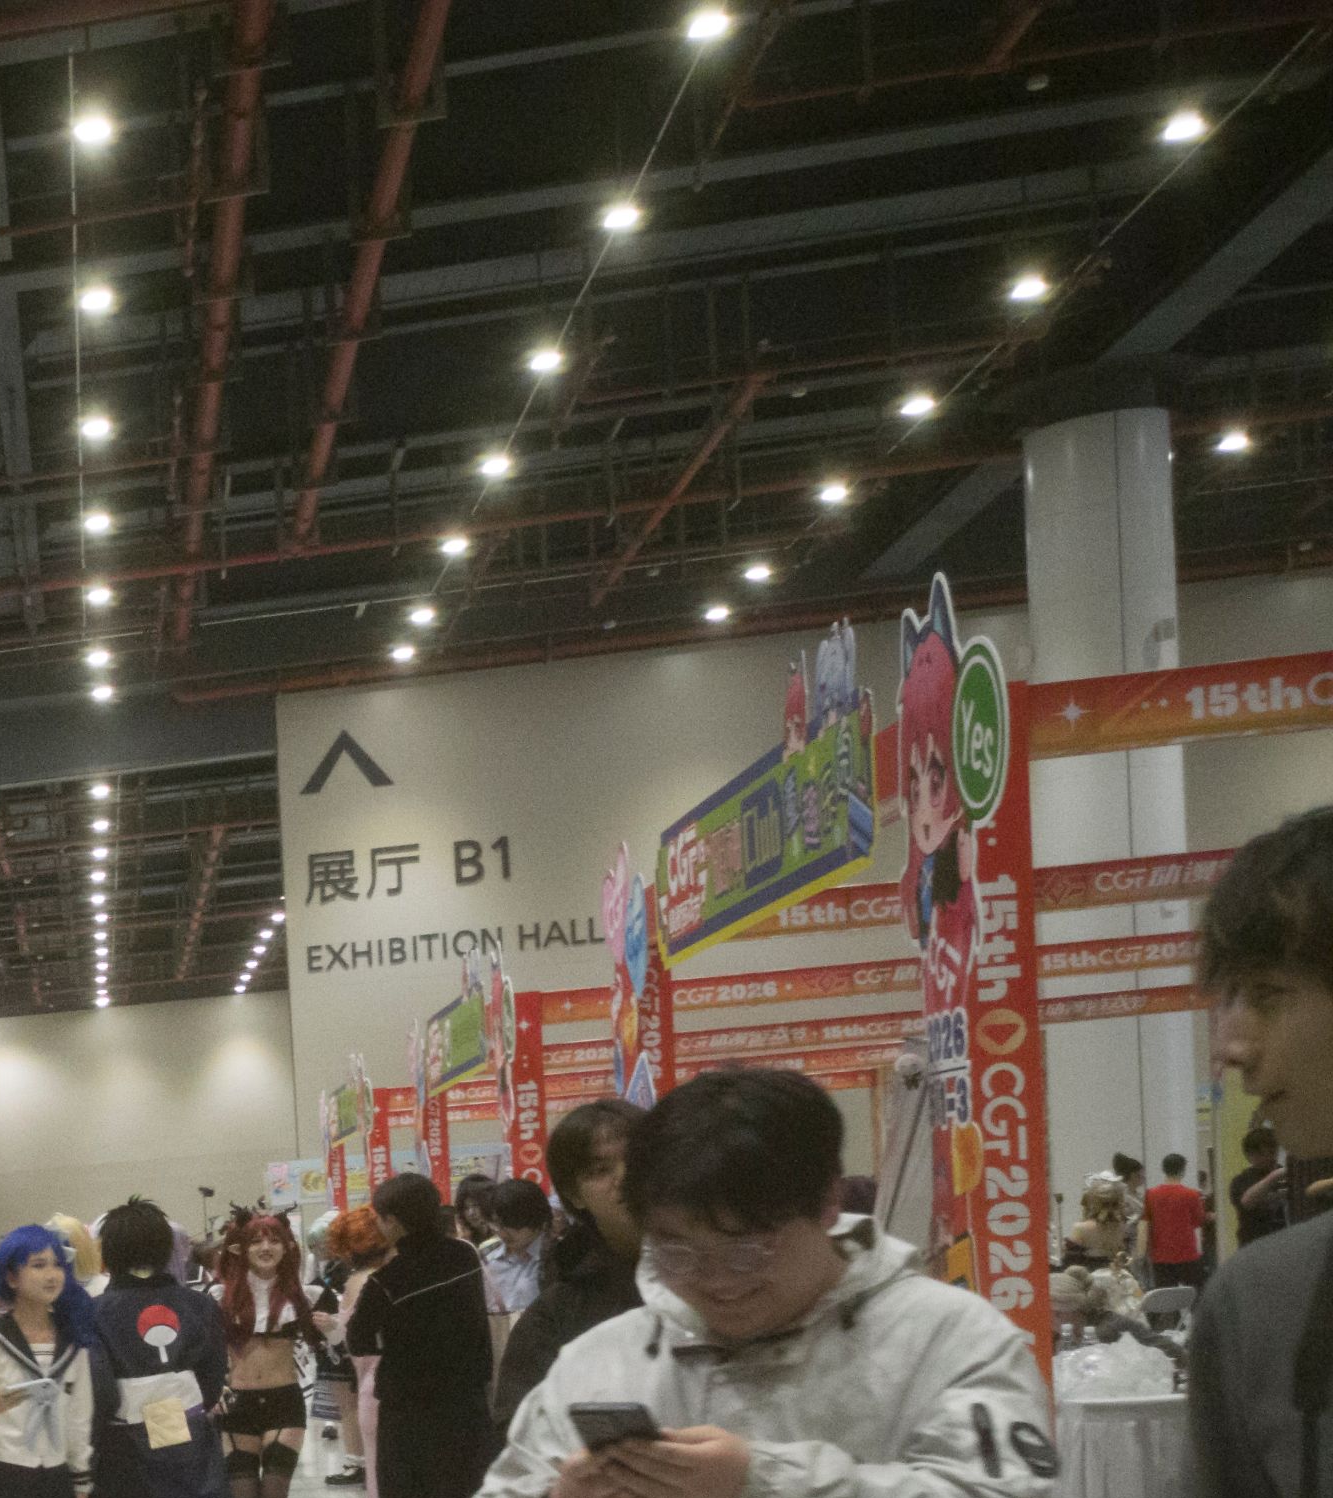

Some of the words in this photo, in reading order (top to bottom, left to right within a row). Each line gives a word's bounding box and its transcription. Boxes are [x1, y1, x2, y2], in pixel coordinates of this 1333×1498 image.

[962, 699, 994, 778] Yes
[305, 843, 420, 906] 展厅
[453, 836, 512, 887] B1
[307, 926, 504, 973] EXHIBITION
[518, 917, 606, 951] HALL
